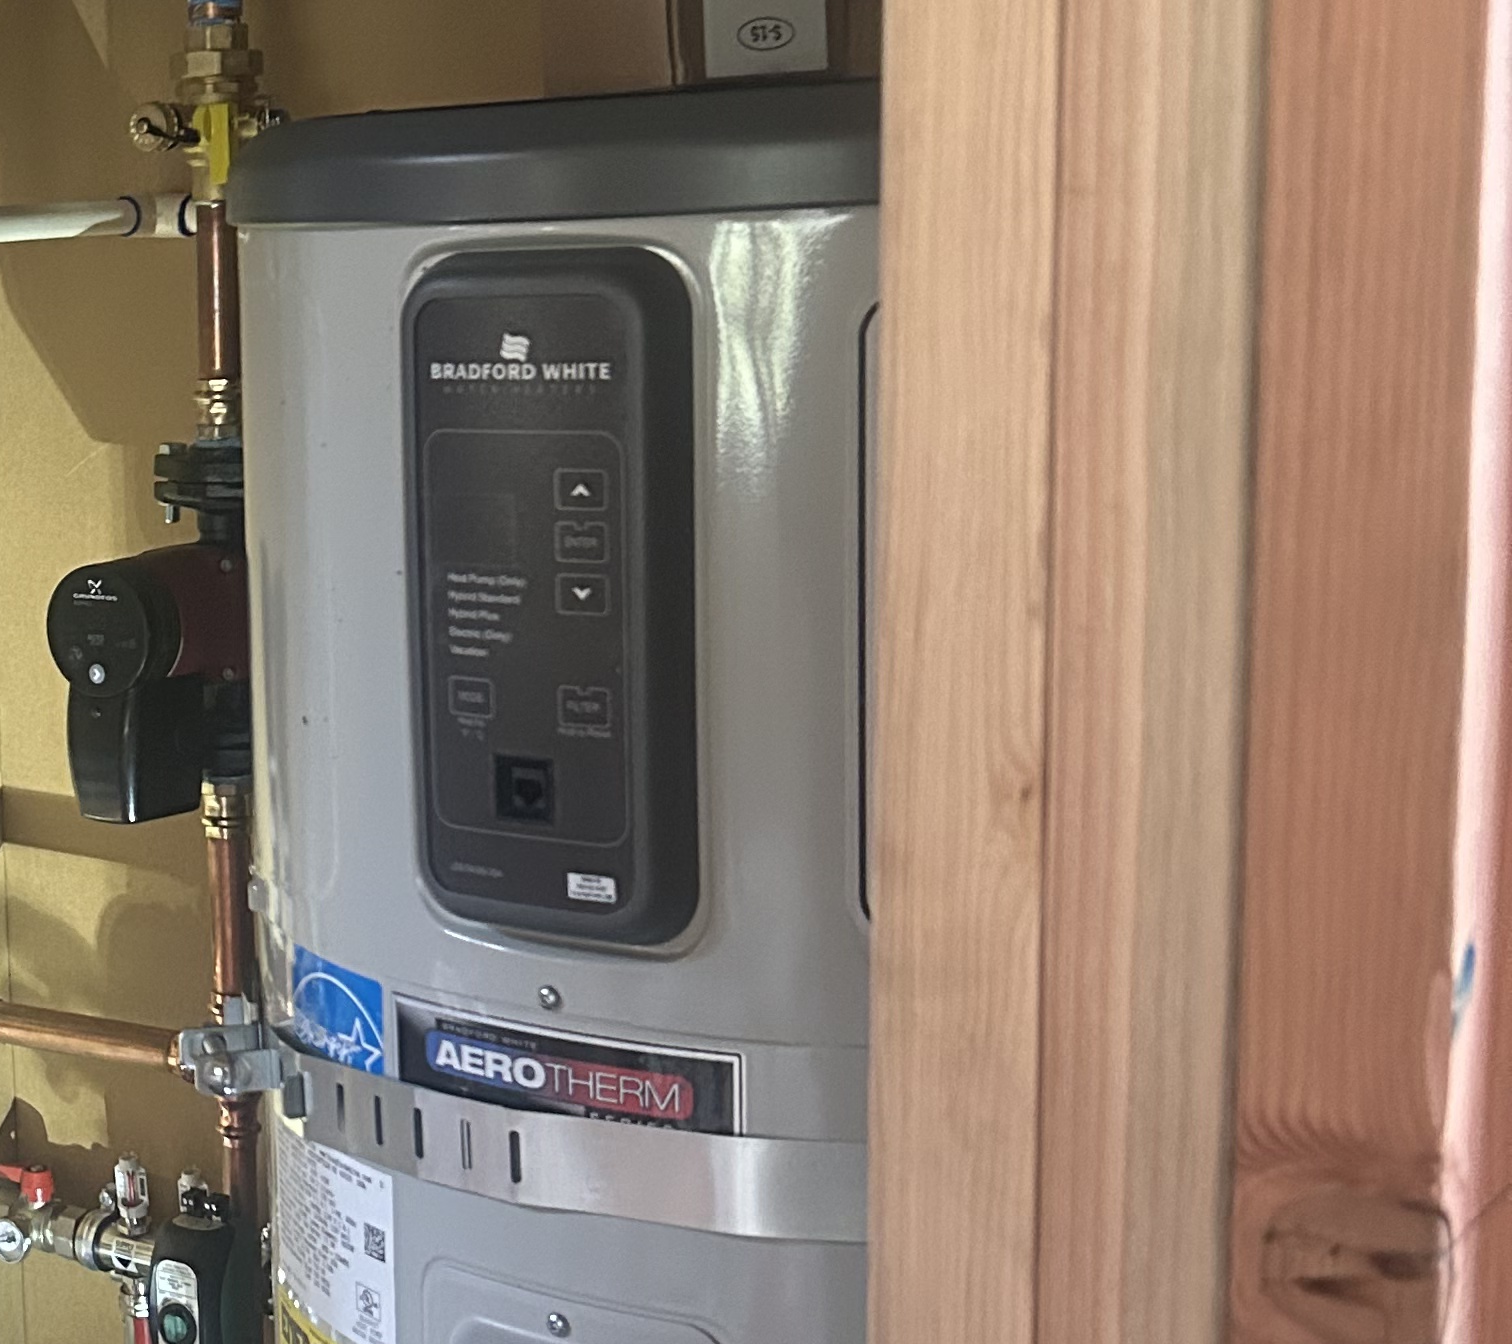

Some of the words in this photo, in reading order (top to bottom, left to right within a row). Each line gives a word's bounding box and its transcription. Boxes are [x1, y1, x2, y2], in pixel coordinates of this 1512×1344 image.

[430, 361, 537, 381] BRADFORD
[542, 361, 613, 381] WHITE
[435, 1039, 681, 1113] AEROTHERM
